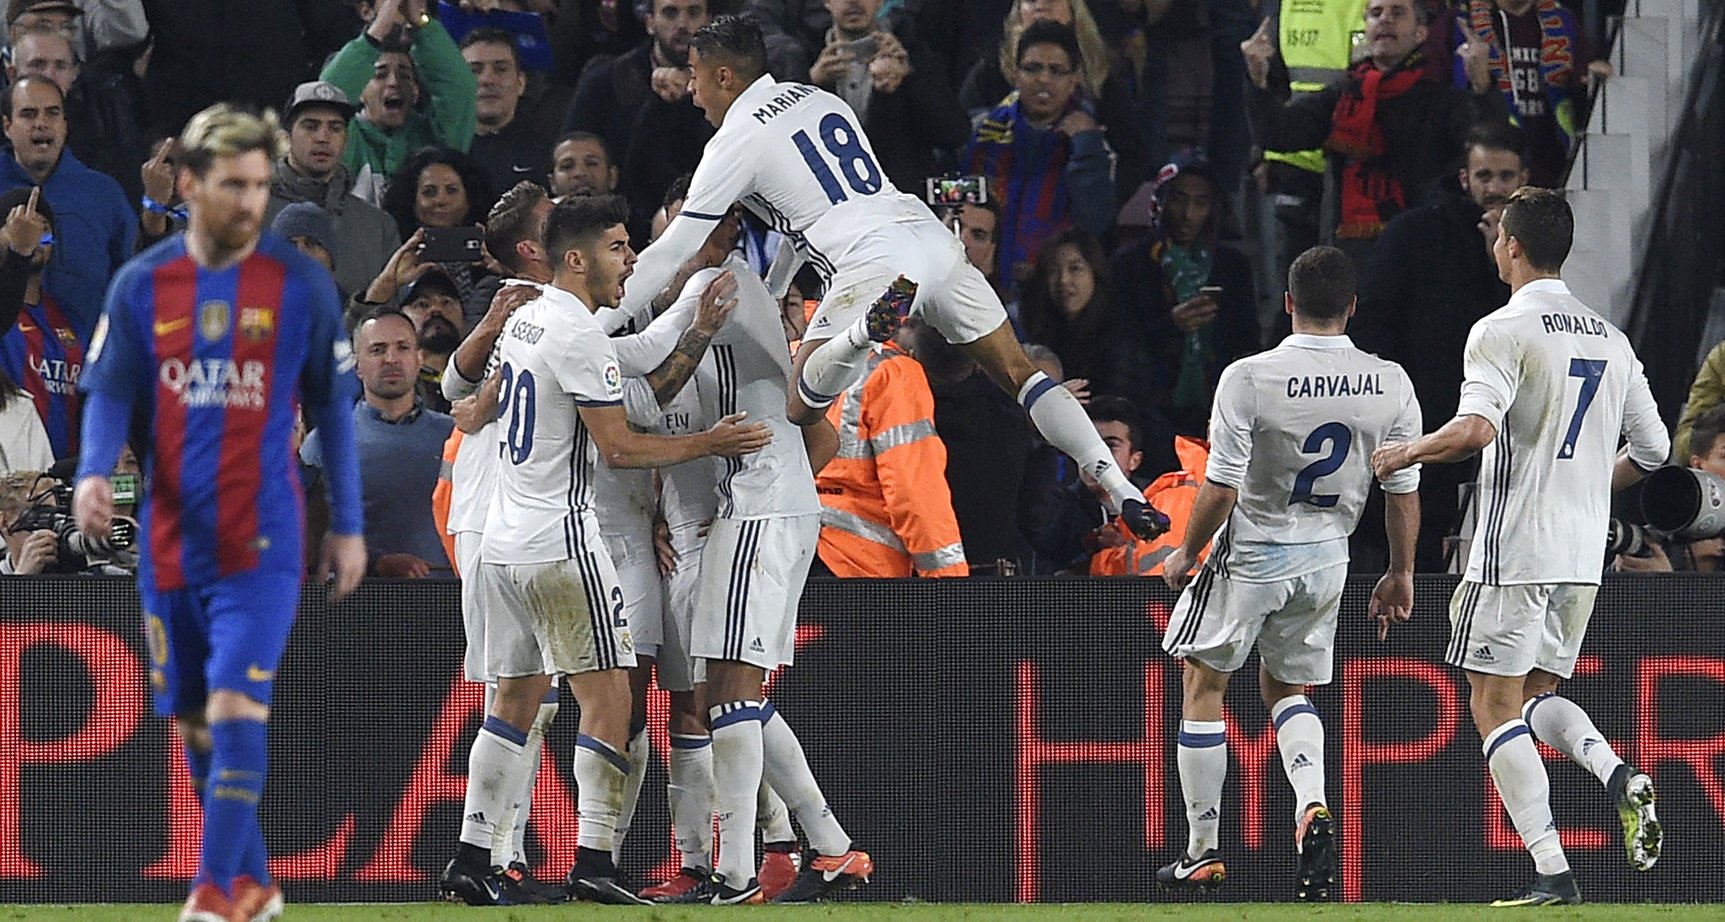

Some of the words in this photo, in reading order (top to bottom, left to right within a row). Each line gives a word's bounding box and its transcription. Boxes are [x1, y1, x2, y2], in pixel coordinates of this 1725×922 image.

[752, 85, 818, 125] MARIAN
[791, 112, 882, 206] 18
[1541, 313, 1609, 339] RONALDO
[160, 358, 265, 394] QATAR
[1287, 373, 1384, 398] CARVAJAL
[665, 412, 690, 430] Fly
[1556, 357, 1609, 460] 7
[1288, 421, 1352, 508] 2
